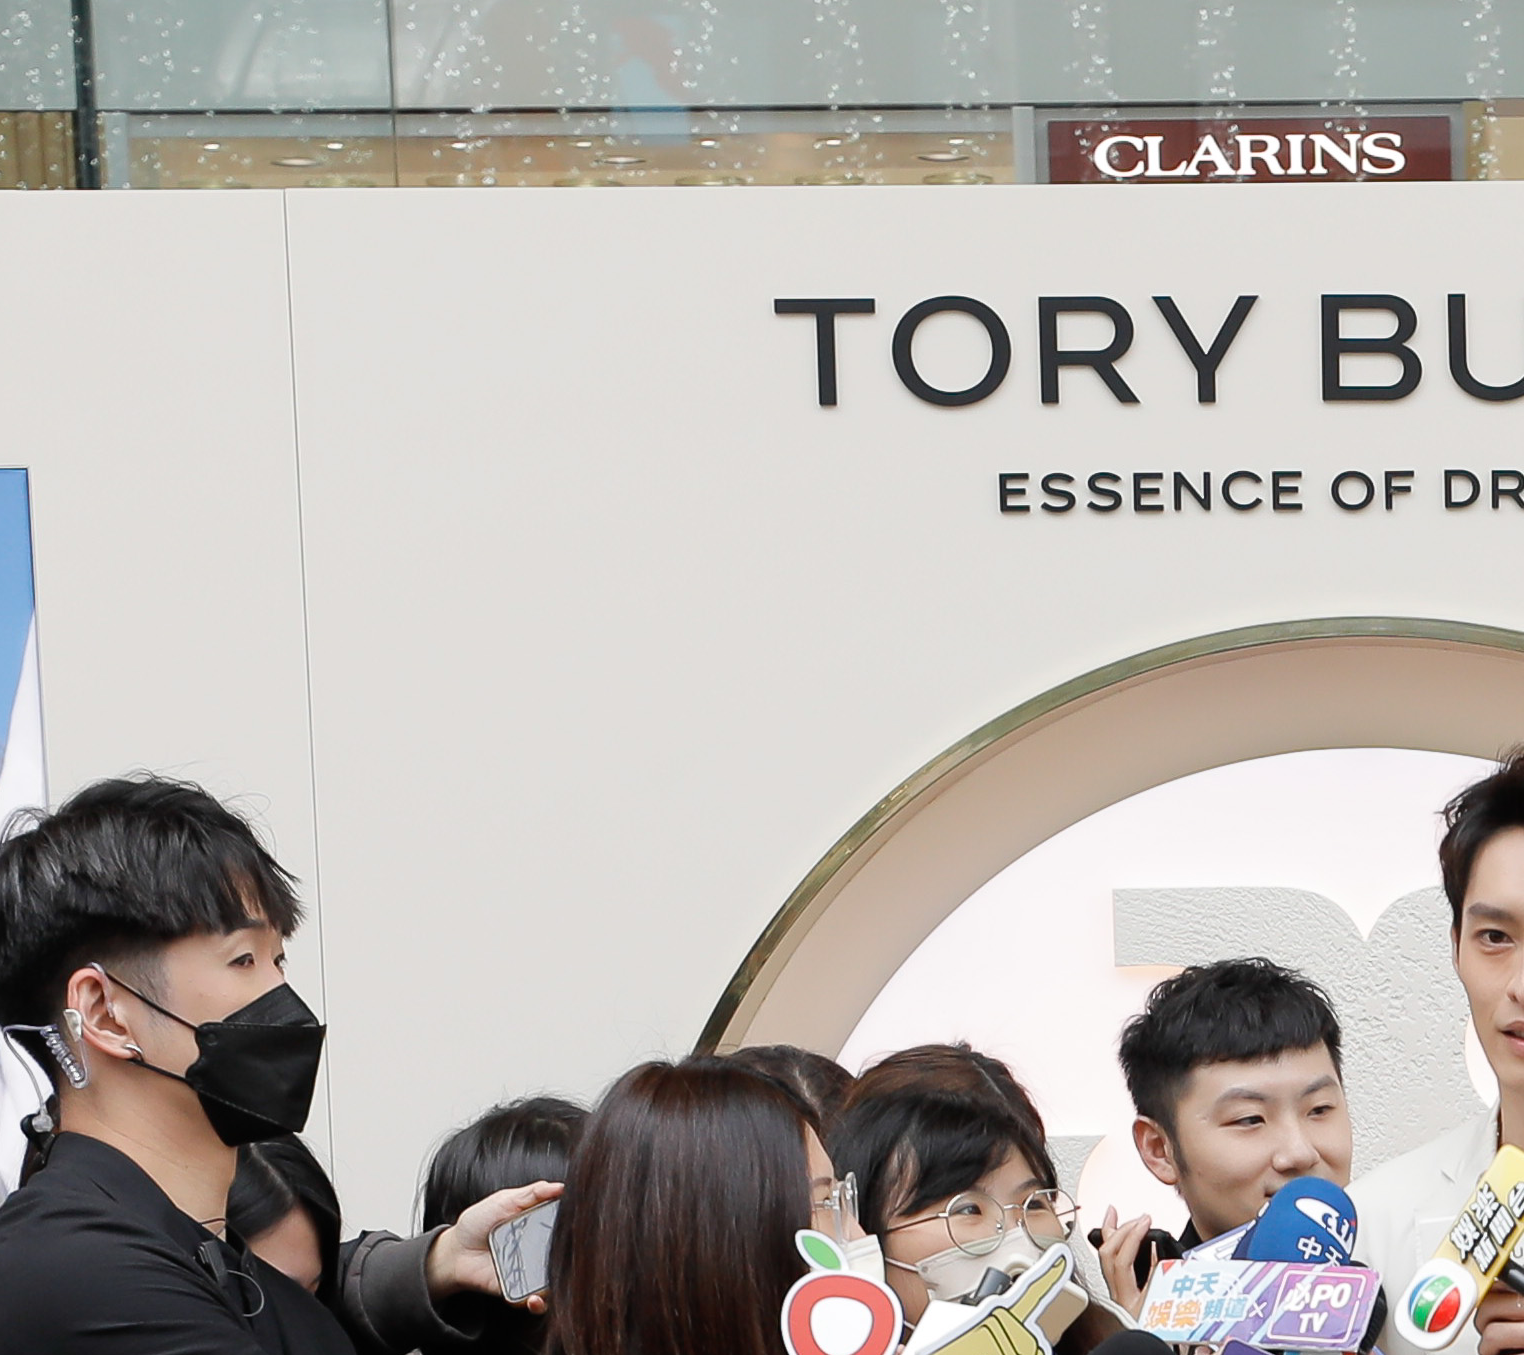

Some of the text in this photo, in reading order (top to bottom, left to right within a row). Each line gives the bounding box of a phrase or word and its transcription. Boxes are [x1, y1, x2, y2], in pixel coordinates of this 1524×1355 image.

[1092, 131, 1406, 179] CLARINS
[773, 295, 1259, 408] TORY
[998, 470, 1303, 514] ESSENCE
[1330, 470, 1415, 512] OF
[1171, 1271, 1221, 1299] 中天
[1298, 1311, 1330, 1334] TV
